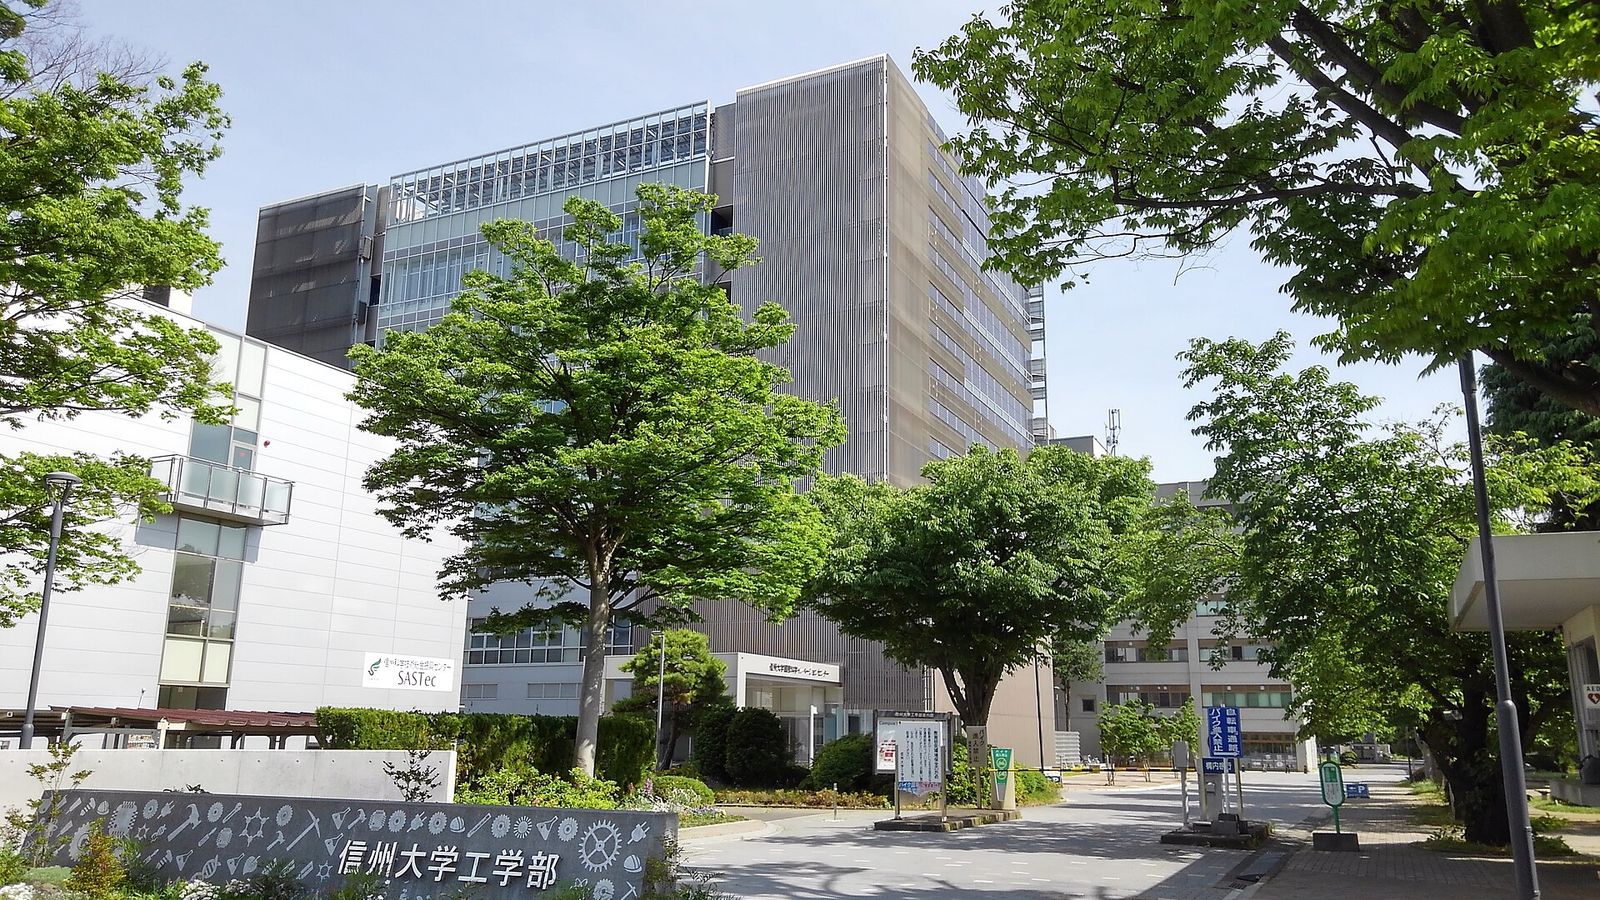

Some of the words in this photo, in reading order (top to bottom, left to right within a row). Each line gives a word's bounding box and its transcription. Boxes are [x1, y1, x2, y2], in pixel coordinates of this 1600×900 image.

[398, 670, 437, 687] SASTec
[1358, 785, 1365, 794] P
[337, 840, 560, 890] 信州大学工学部
